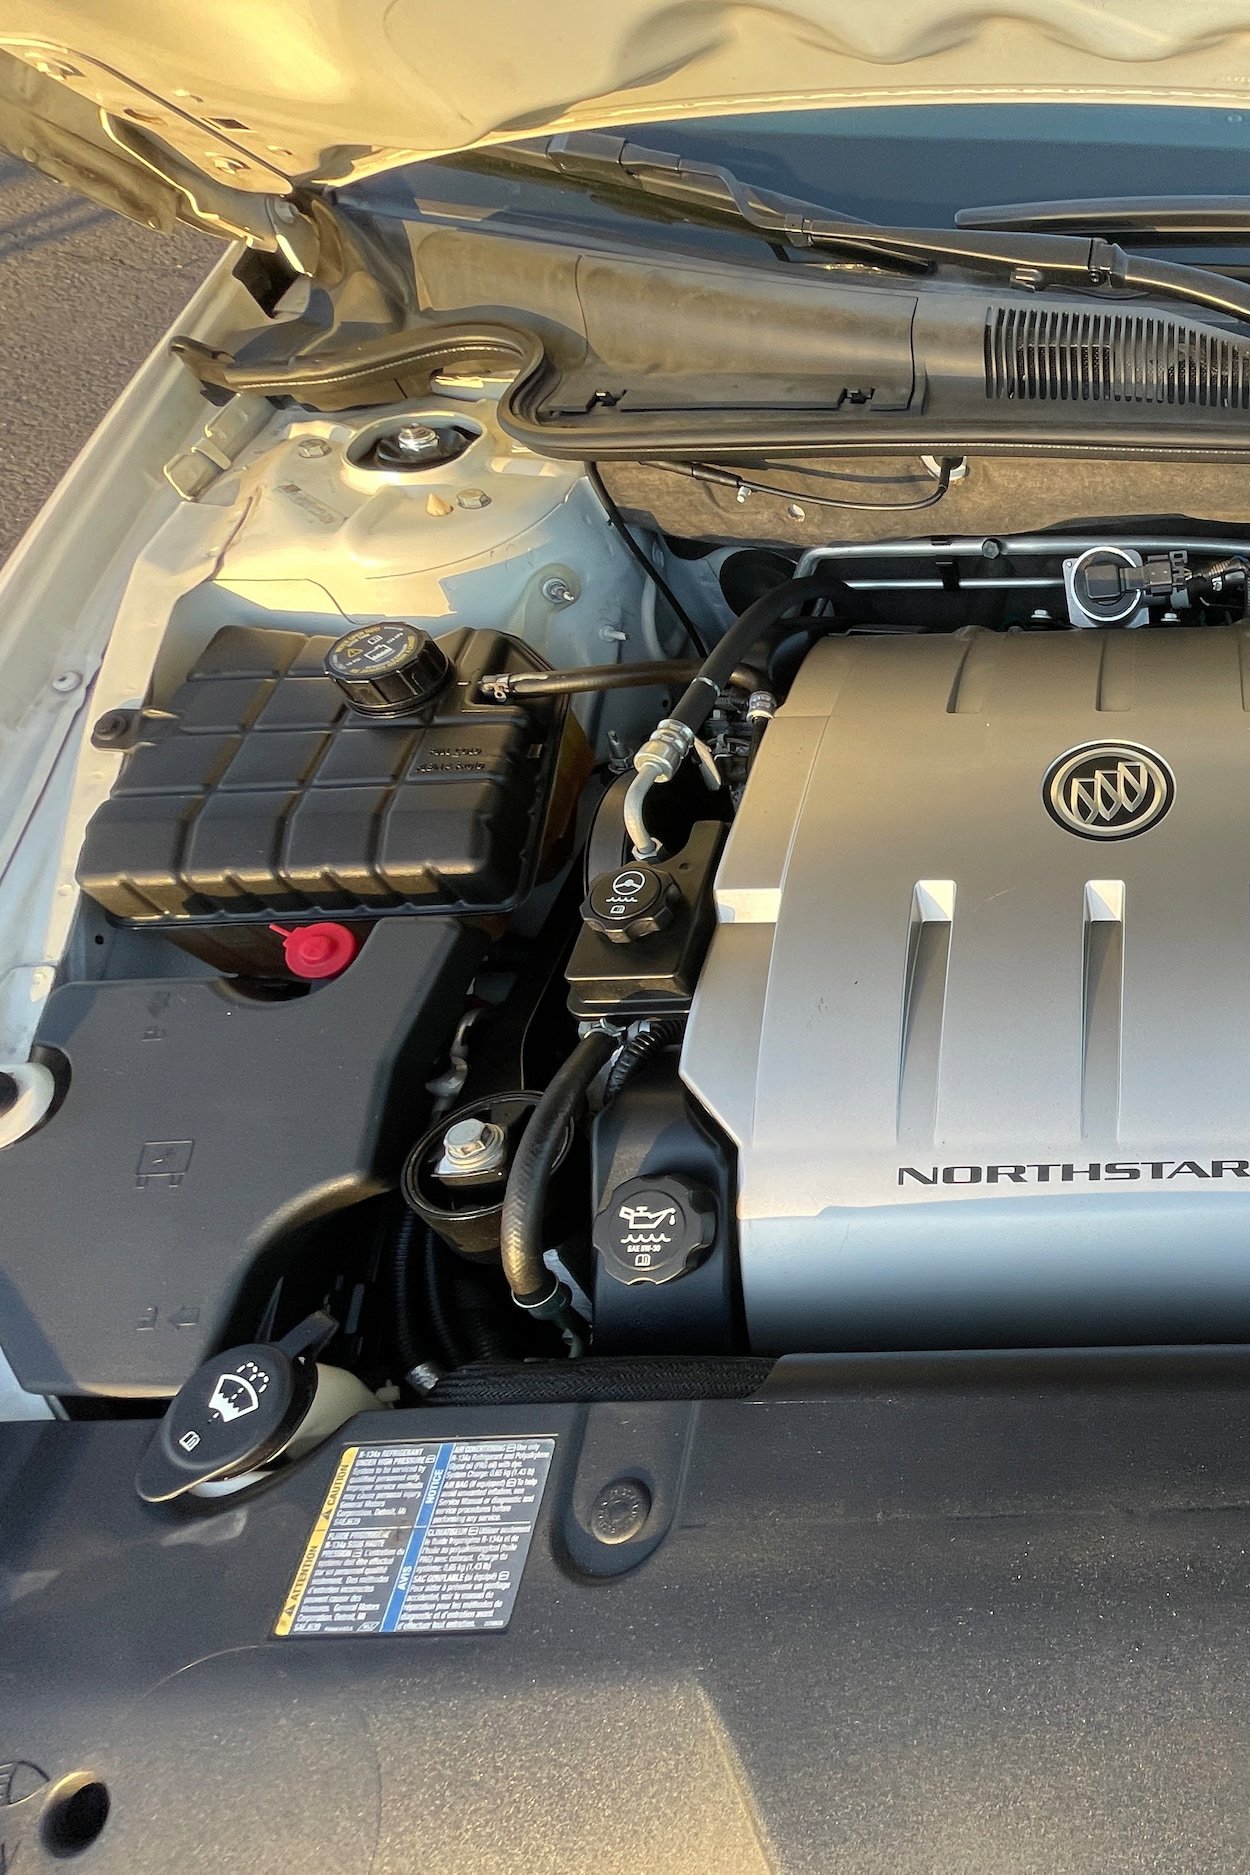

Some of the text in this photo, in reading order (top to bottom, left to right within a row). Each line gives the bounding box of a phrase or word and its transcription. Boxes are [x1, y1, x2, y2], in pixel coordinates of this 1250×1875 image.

[328, 1464, 349, 1508] CAUTION
[425, 1469, 445, 1504] NOTICE
[292, 1545, 318, 1600] ATTENTION
[398, 1566, 412, 1591] AVIS
